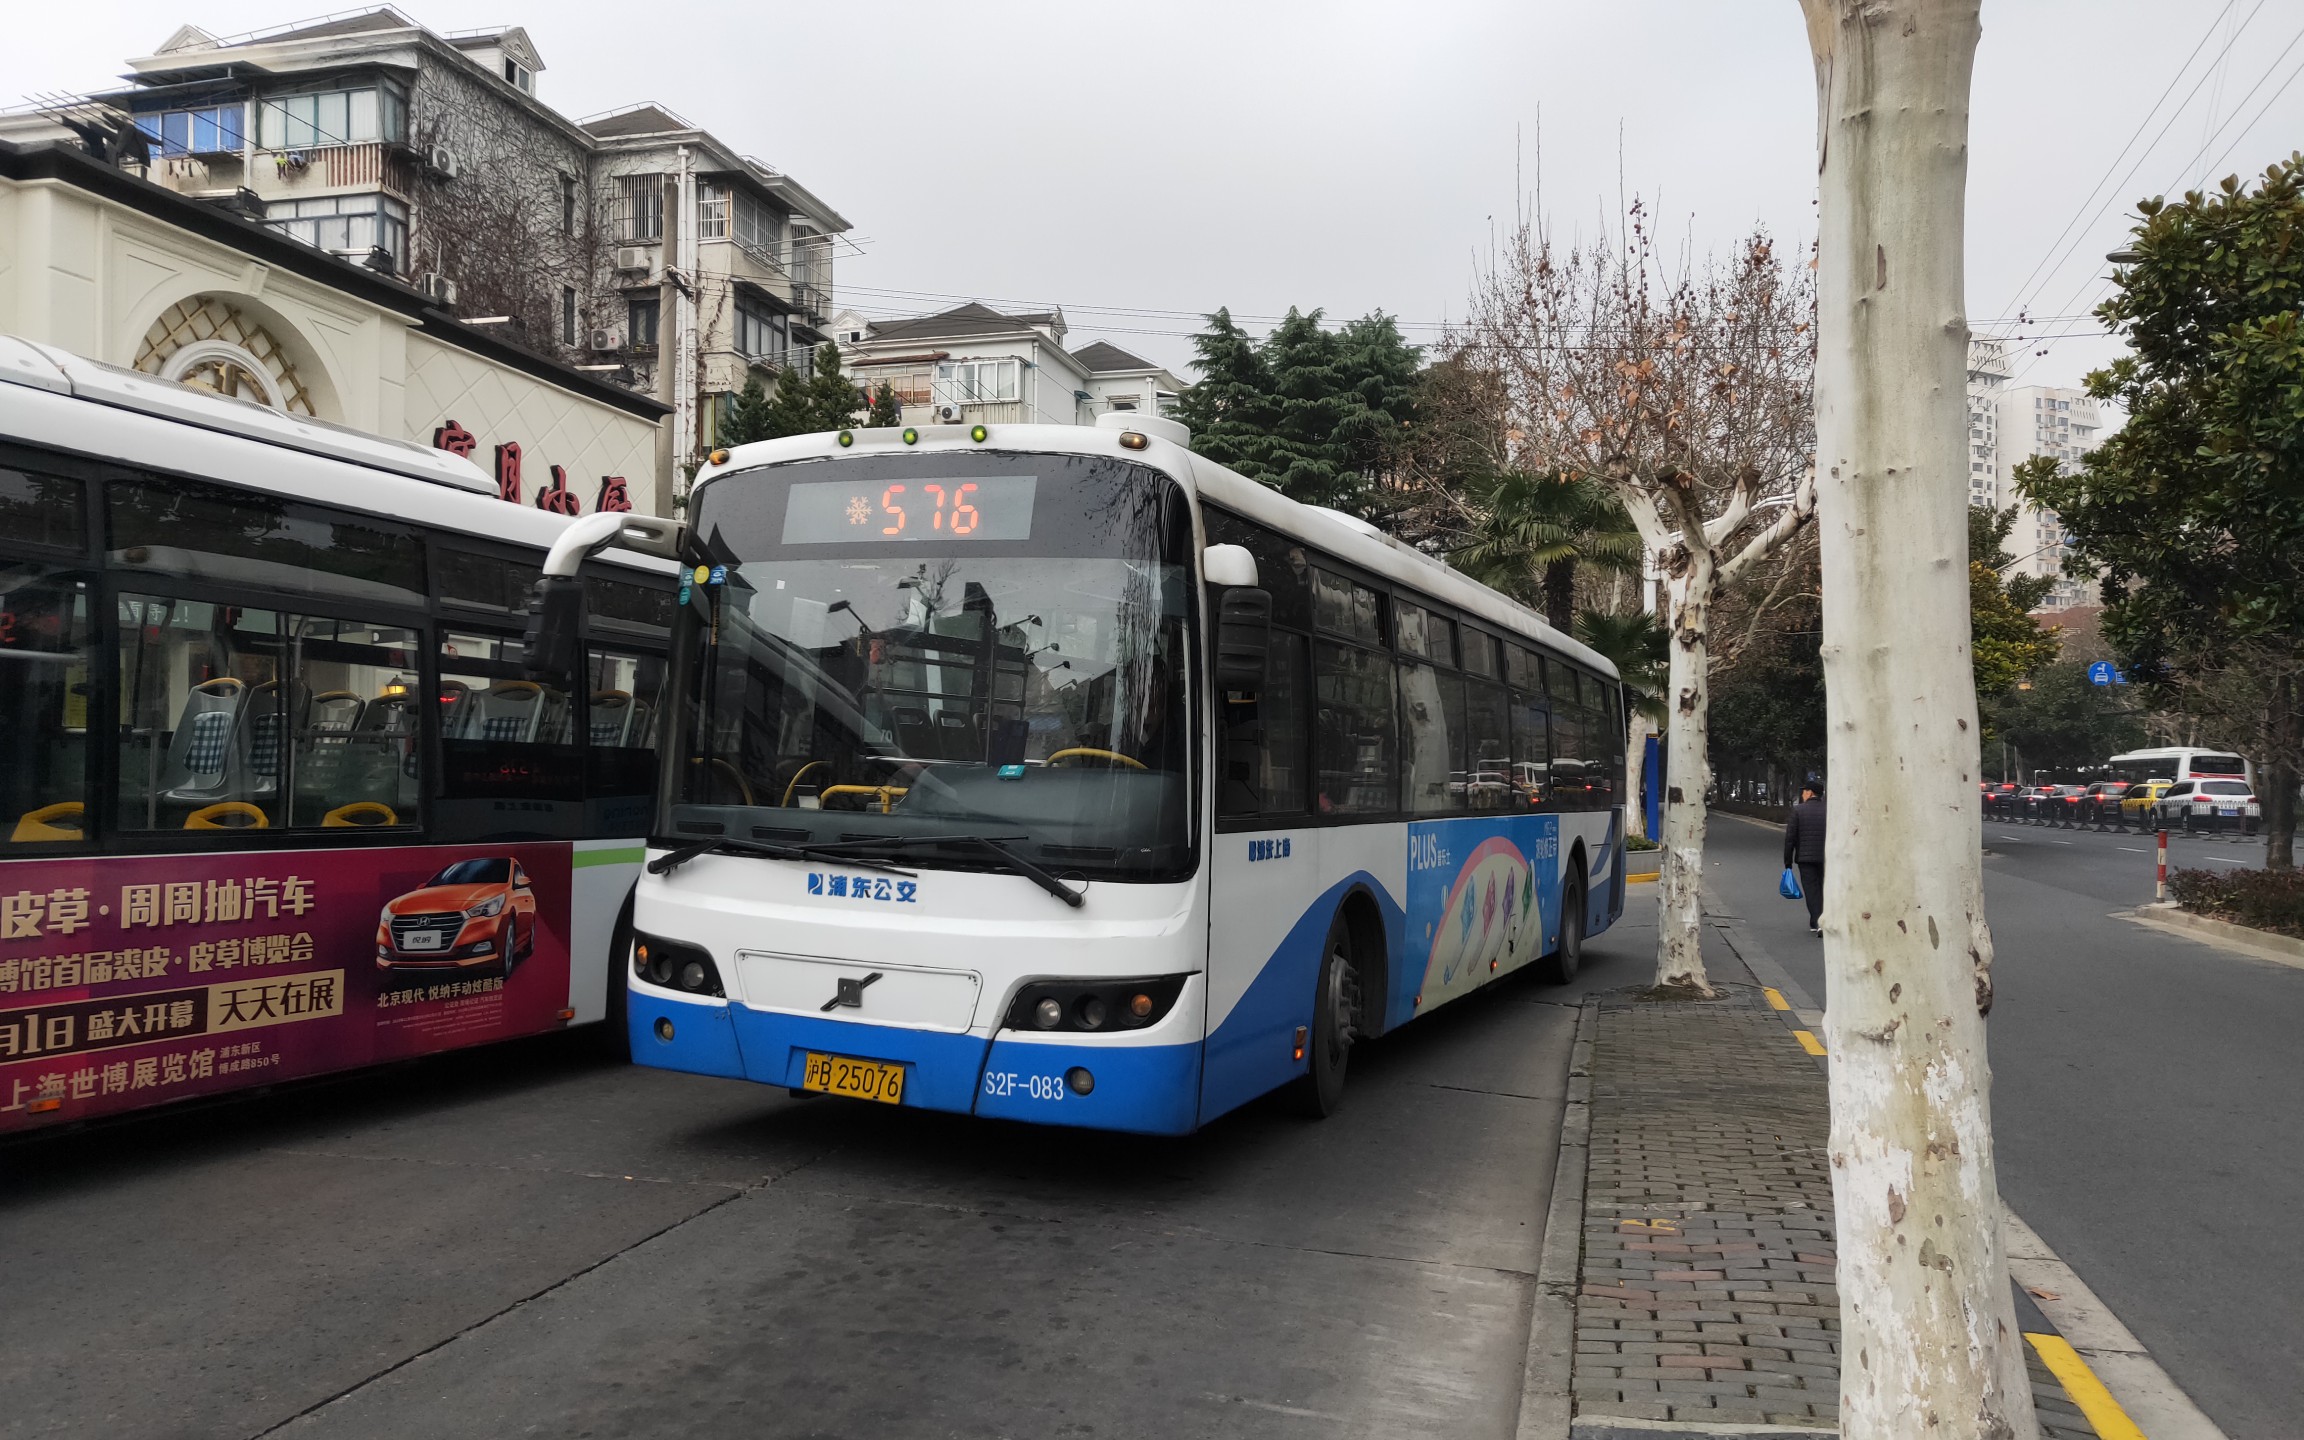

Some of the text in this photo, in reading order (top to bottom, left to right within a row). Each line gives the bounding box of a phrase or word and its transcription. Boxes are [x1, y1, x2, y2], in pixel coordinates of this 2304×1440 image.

[882, 484, 979, 535] 576
[1410, 832, 1437, 872] PLUS
[828, 874, 917, 903] 浦东公交
[219, 977, 335, 1026] 天天在展
[377, 987, 425, 1008] 北京现代
[428, 976, 504, 1000] 悦纳手动炫酷版
[87, 999, 194, 1041] 盛大开幕
[218, 1053, 281, 1076] 博成路850号
[219, 1041, 261, 1059] 浦东新区
[0, 1047, 216, 1112] 上海世博展览馆
[985, 1071, 1064, 1101] S2F-083
